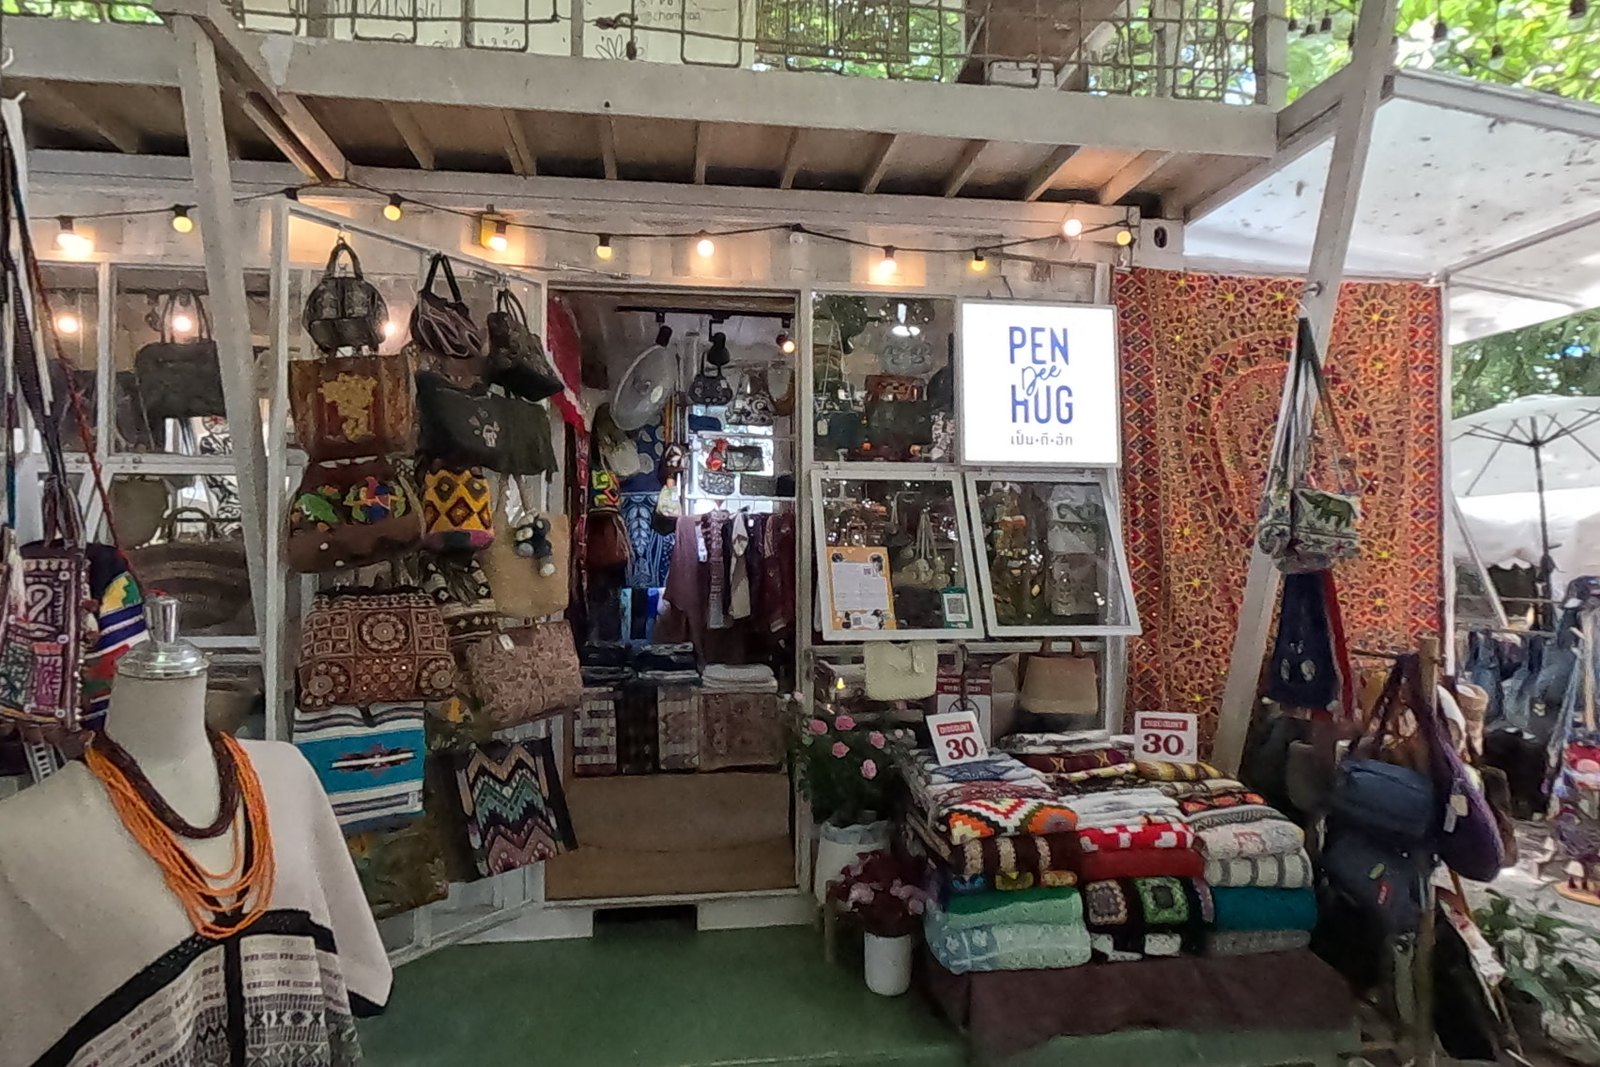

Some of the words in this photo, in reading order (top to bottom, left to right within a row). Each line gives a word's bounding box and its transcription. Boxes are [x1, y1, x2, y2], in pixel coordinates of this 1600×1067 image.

[1009, 326, 1069, 366] PEN
[1011, 384, 1074, 425] HUG
[945, 736, 979, 760] 30
[1142, 733, 1184, 756] 30
